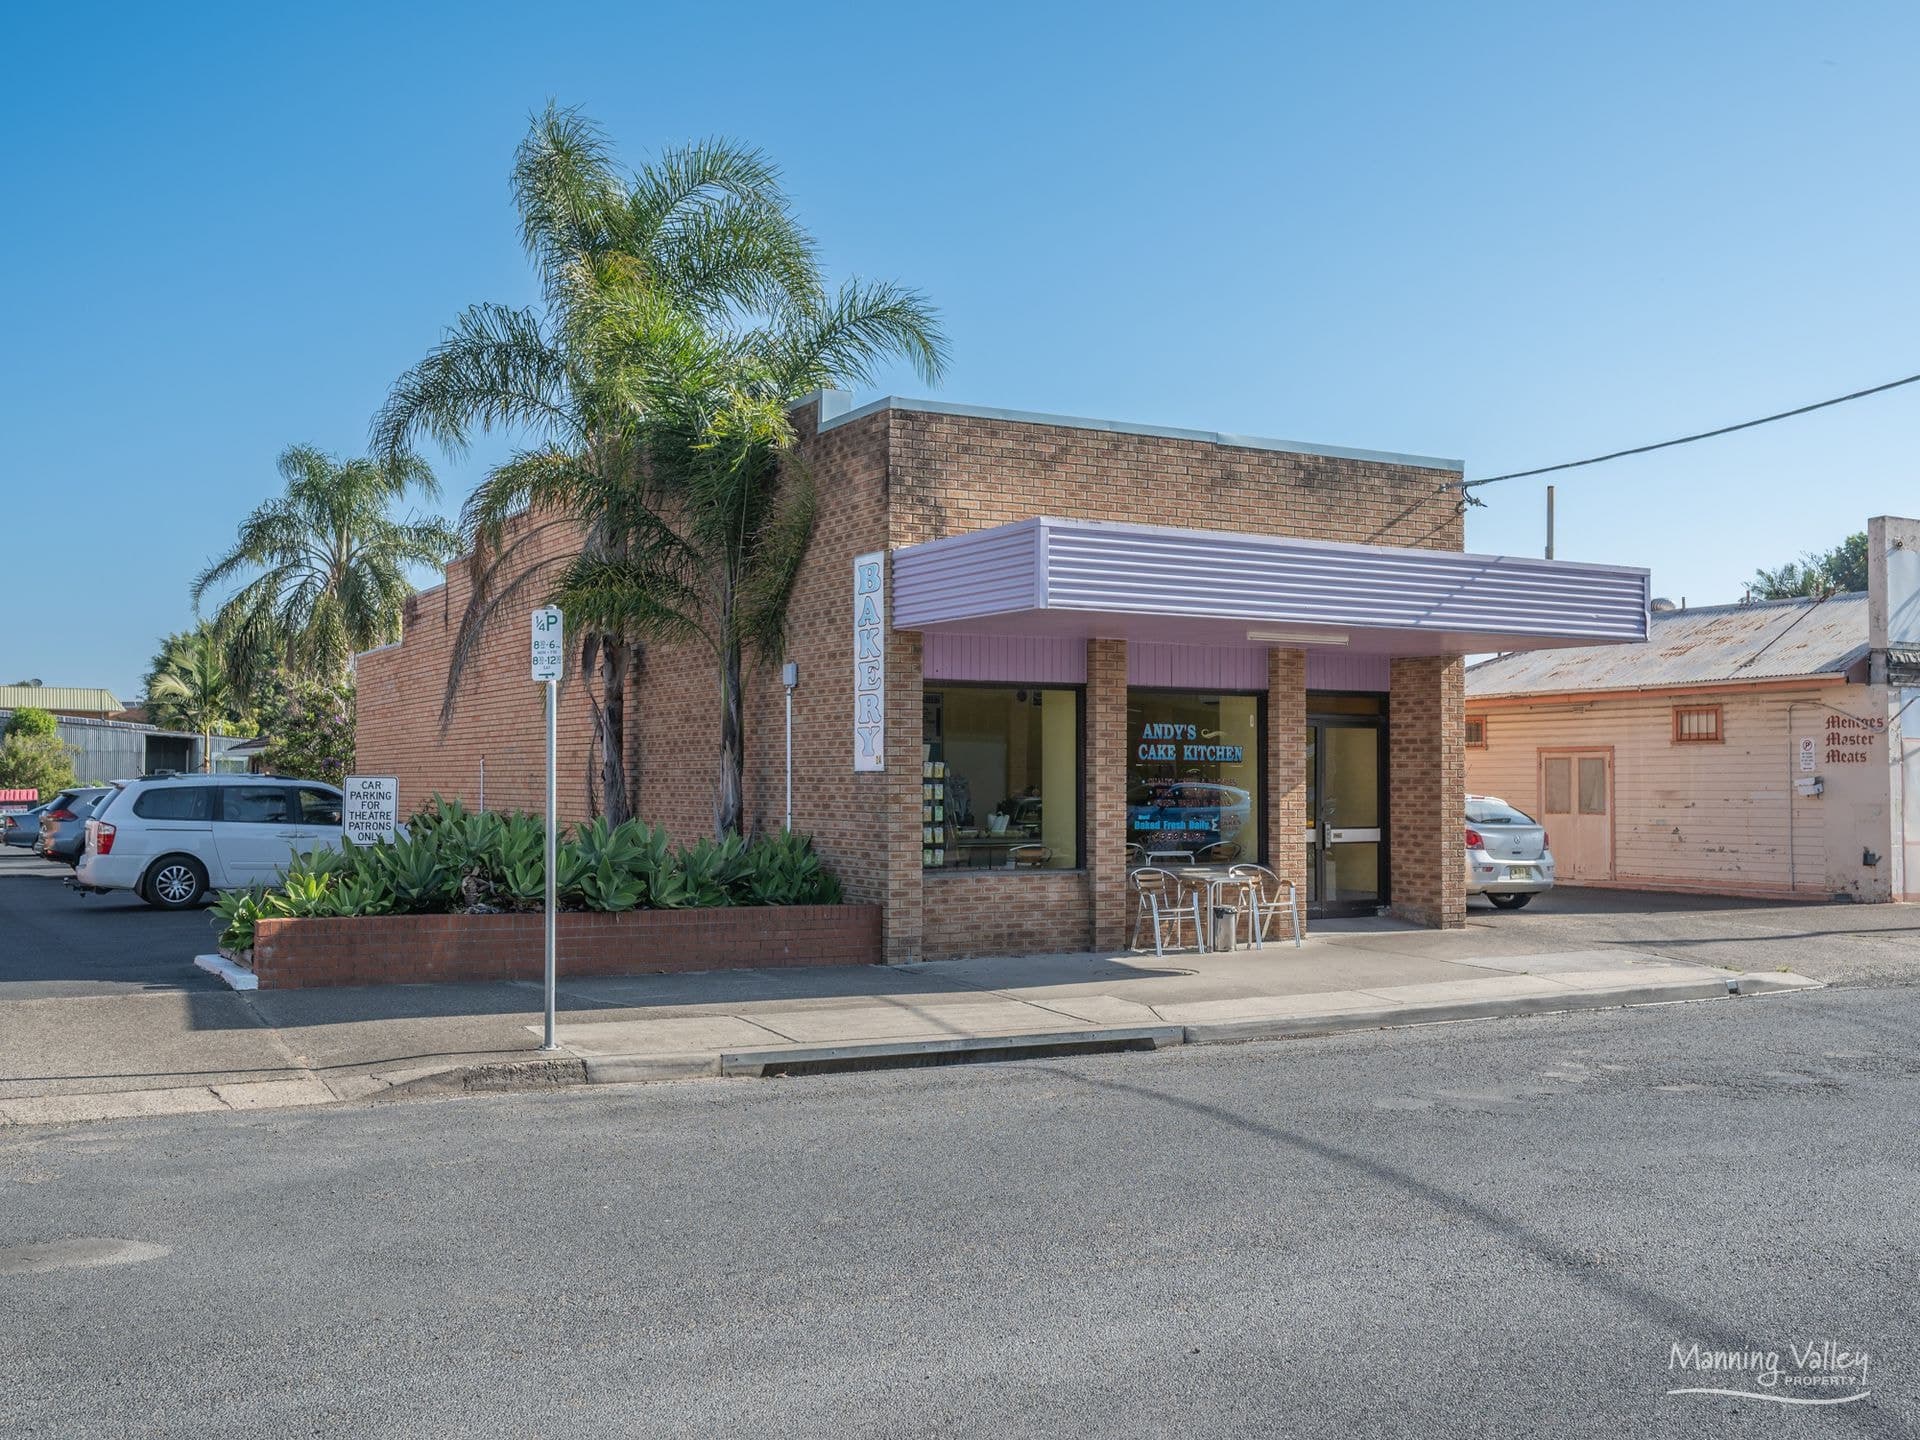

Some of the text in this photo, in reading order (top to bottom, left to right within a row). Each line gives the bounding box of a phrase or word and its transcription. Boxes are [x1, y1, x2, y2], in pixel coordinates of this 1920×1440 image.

[857, 562, 882, 757] BAKERY
[1142, 723, 1197, 740] ANDY'S
[1825, 732, 1875, 747] Master
[1138, 744, 1244, 763] CAKE KITCHEN
[1825, 749, 1867, 763] Meats
[361, 781, 382, 790] CAR
[350, 791, 392, 800] PARKING
[361, 801, 380, 810] FOR
[349, 811, 392, 821] THEATRE
[348, 821, 392, 831] PATRONS
[1134, 820, 1211, 831] Baked Fresh Daily
